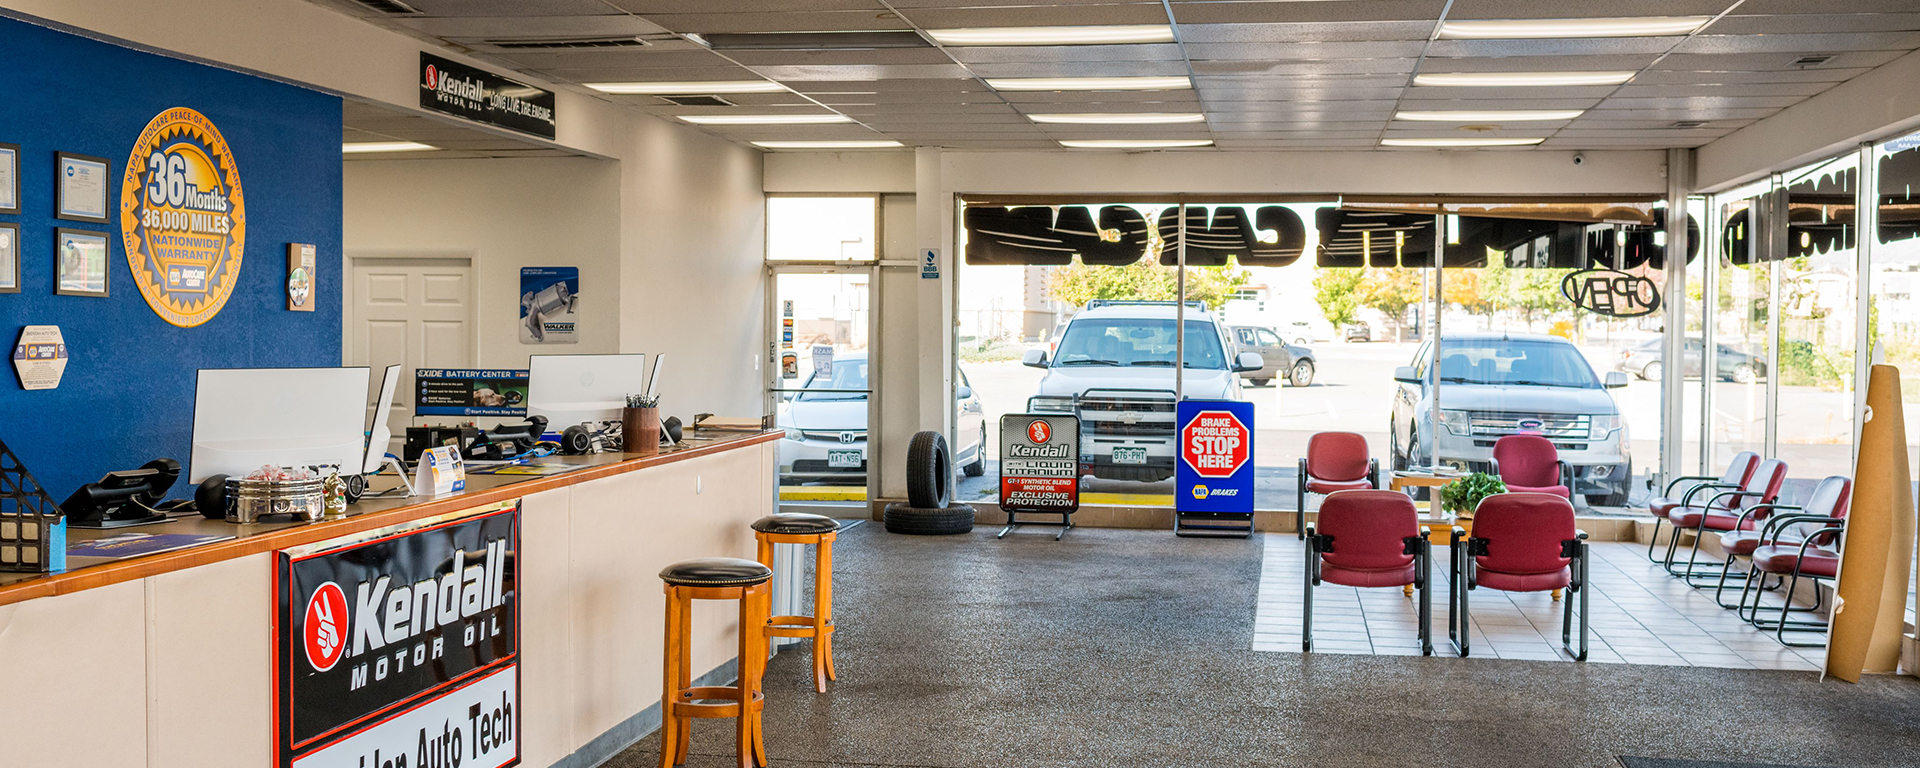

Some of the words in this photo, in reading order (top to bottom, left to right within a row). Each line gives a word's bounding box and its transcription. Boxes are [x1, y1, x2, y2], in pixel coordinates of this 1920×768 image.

[438, 70, 483, 102] Kendall
[437, 93, 465, 108] MOTOR
[469, 101, 482, 111] OIL
[490, 91, 507, 112] LONG
[507, 97, 520, 114] LIVE
[520, 100, 532, 117] THE
[127, 153, 140, 183] NAPA
[138, 115, 169, 152] AUTOCARE
[170, 111, 222, 144] PEACE-OF-MIND
[221, 143, 242, 198] WARRANTY
[149, 151, 186, 206] 36
[185, 184, 228, 212] Months
[142, 208, 189, 232] 36,000
[190, 211, 230, 235] MILES
[152, 234, 221, 249] NATIONWIDE
[157, 247, 217, 261] WARRANTY
[125, 231, 143, 284] HONORED
[142, 284, 151, 296] AT
[150, 296, 189, 324] CONVENIENT
[190, 298, 224, 324] LOCATIONS
[223, 242, 243, 299] NATIONALLY
[544, 322, 575, 332] WALKER
[417, 370, 443, 378] EXIDE
[446, 370, 481, 378] BATTERY
[1200, 418, 1231, 427] BRAKE
[1191, 427, 1240, 436] PROBLEMS
[1010, 444, 1069, 458] Kendall
[1191, 436, 1240, 455] STOP
[1025, 461, 1073, 469] LIQUID
[1197, 455, 1234, 468] HERE
[1006, 468, 1073, 476] TITANIUM
[1010, 491, 1069, 499] EXCLUSIVE
[1194, 488, 1207, 496] NAPA
[1006, 498, 1074, 506] PROTECTION
[352, 538, 506, 657] Kendall
[350, 635, 444, 691] MOTOR
[464, 614, 500, 648] OIL
[416, 717, 463, 768] Auto
[468, 690, 512, 761] Tech
